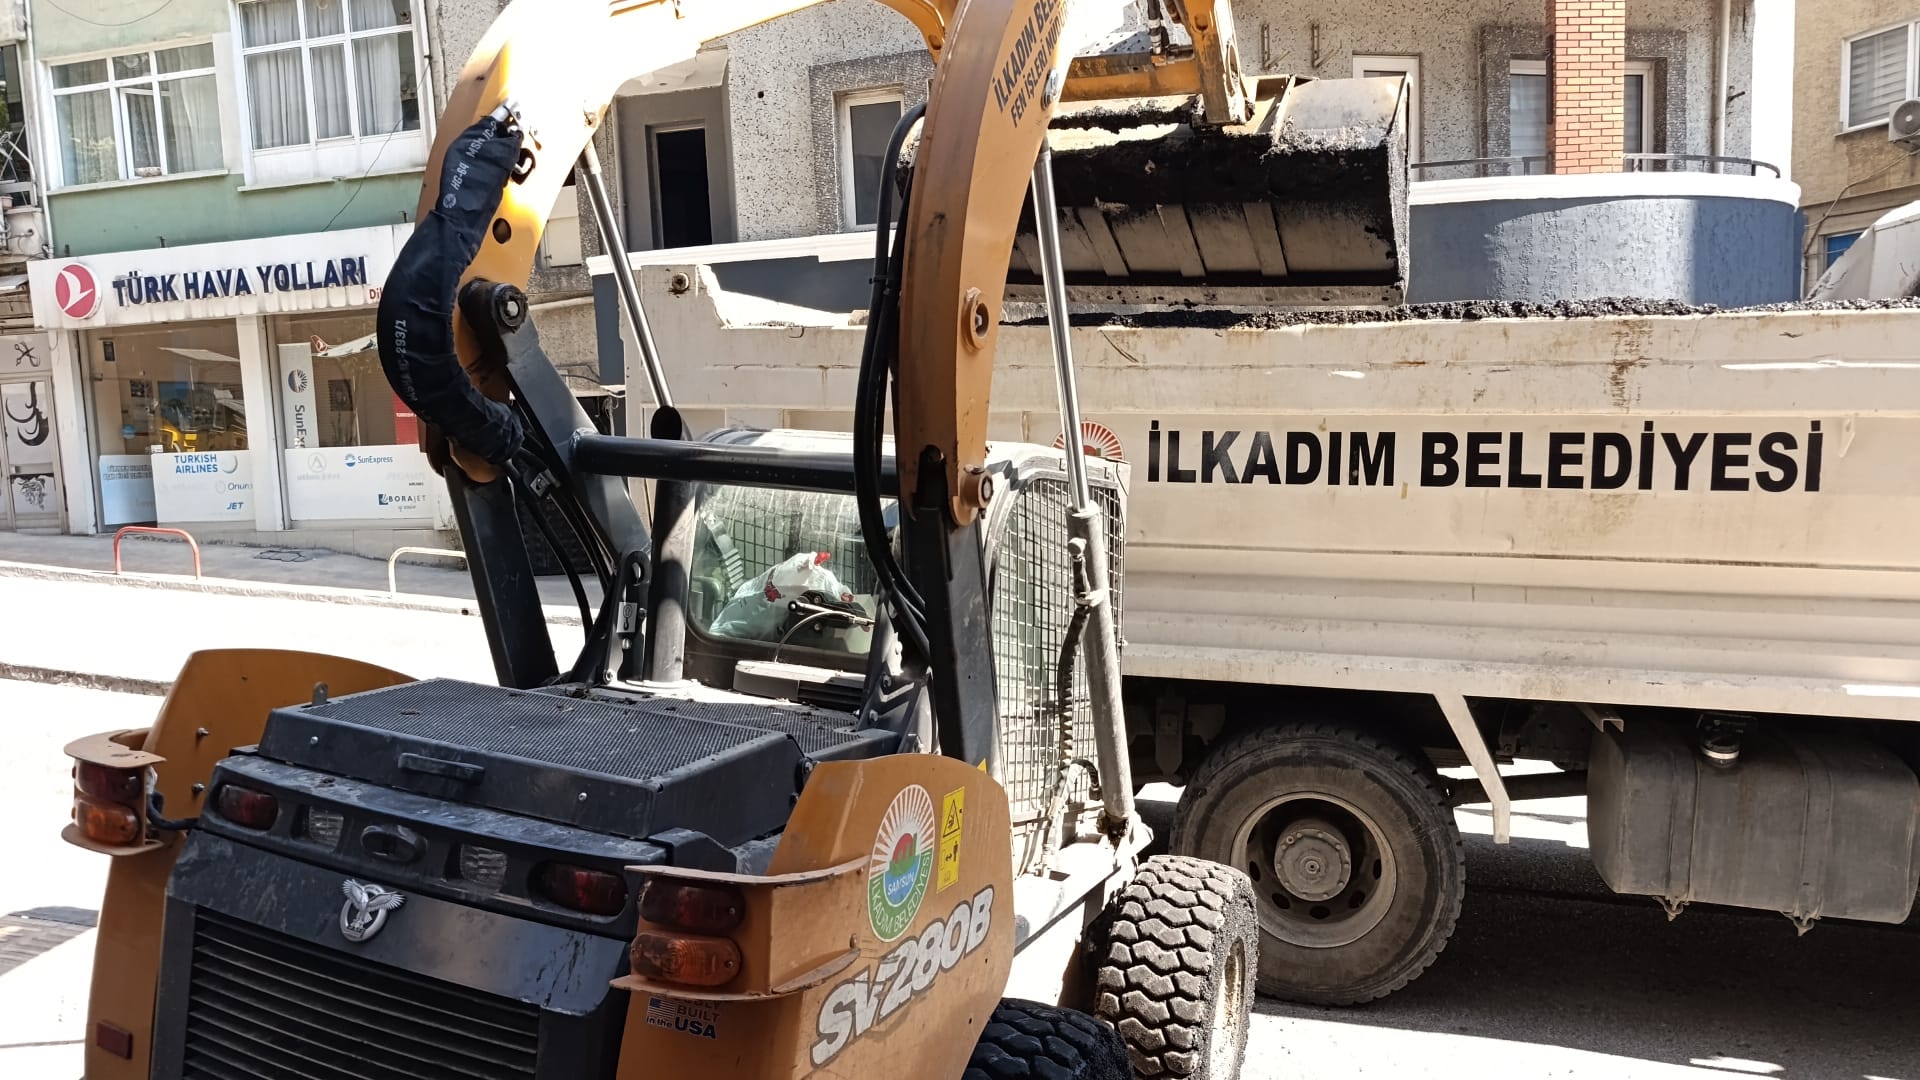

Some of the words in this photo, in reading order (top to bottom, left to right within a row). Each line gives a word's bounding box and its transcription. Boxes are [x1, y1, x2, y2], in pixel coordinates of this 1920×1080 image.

[992, 16, 1037, 112] İLKADIM
[1011, 88, 1027, 128] FEN
[112, 271, 179, 307] TÜRK
[184, 268, 252, 300] HAVA
[256, 256, 369, 293] YOLLARI
[174, 454, 217, 464] TURKISH
[357, 455, 394, 465] SunExpress
[1147, 419, 1396, 487] İLKADIM
[1420, 420, 1824, 493] BELEDİYESİ
[175, 464, 219, 474] AIRLINES
[226, 502, 244, 511] JET
[388, 494, 426, 504] BORAJET
[676, 1004, 720, 1022] BUILT
[657, 1017, 673, 1028] the
[674, 1015, 717, 1040] USA
